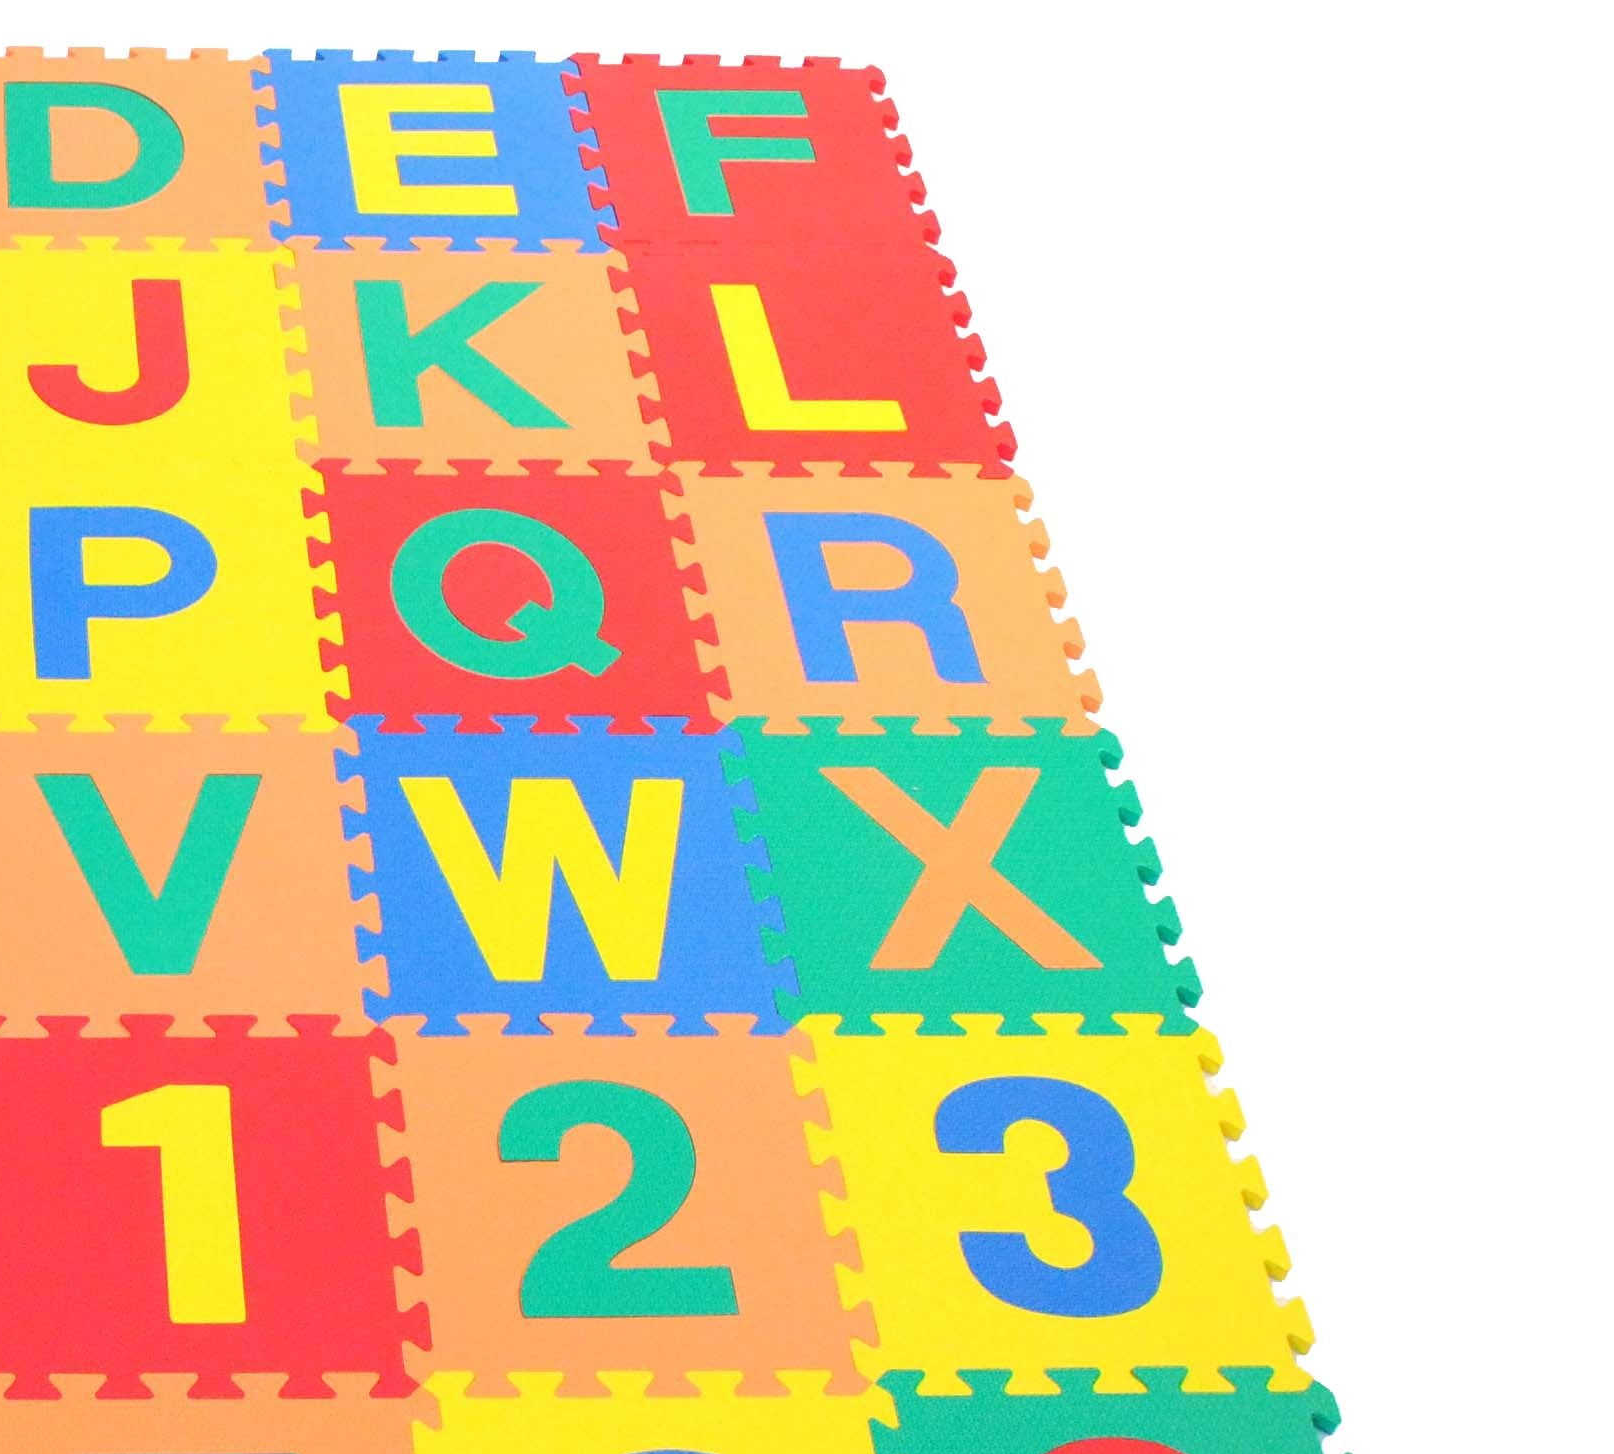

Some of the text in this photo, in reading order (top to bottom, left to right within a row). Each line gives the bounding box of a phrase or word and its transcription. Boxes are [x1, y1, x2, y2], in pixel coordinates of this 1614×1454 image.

[6, 83, 183, 208] D
[340, 85, 517, 214] E
[659, 91, 813, 213] F
[31, 282, 187, 423] J
[356, 281, 569, 429] K
[712, 285, 905, 430] L
[31, 508, 216, 678] P
[393, 510, 619, 677] Q
[766, 514, 981, 682] R
[38, 775, 259, 974] V
[401, 778, 683, 981] W
[826, 769, 1098, 969] X
[103, 1086, 245, 1322] 1
[500, 1082, 737, 1317] 2
[937, 1078, 1160, 1316] 3
